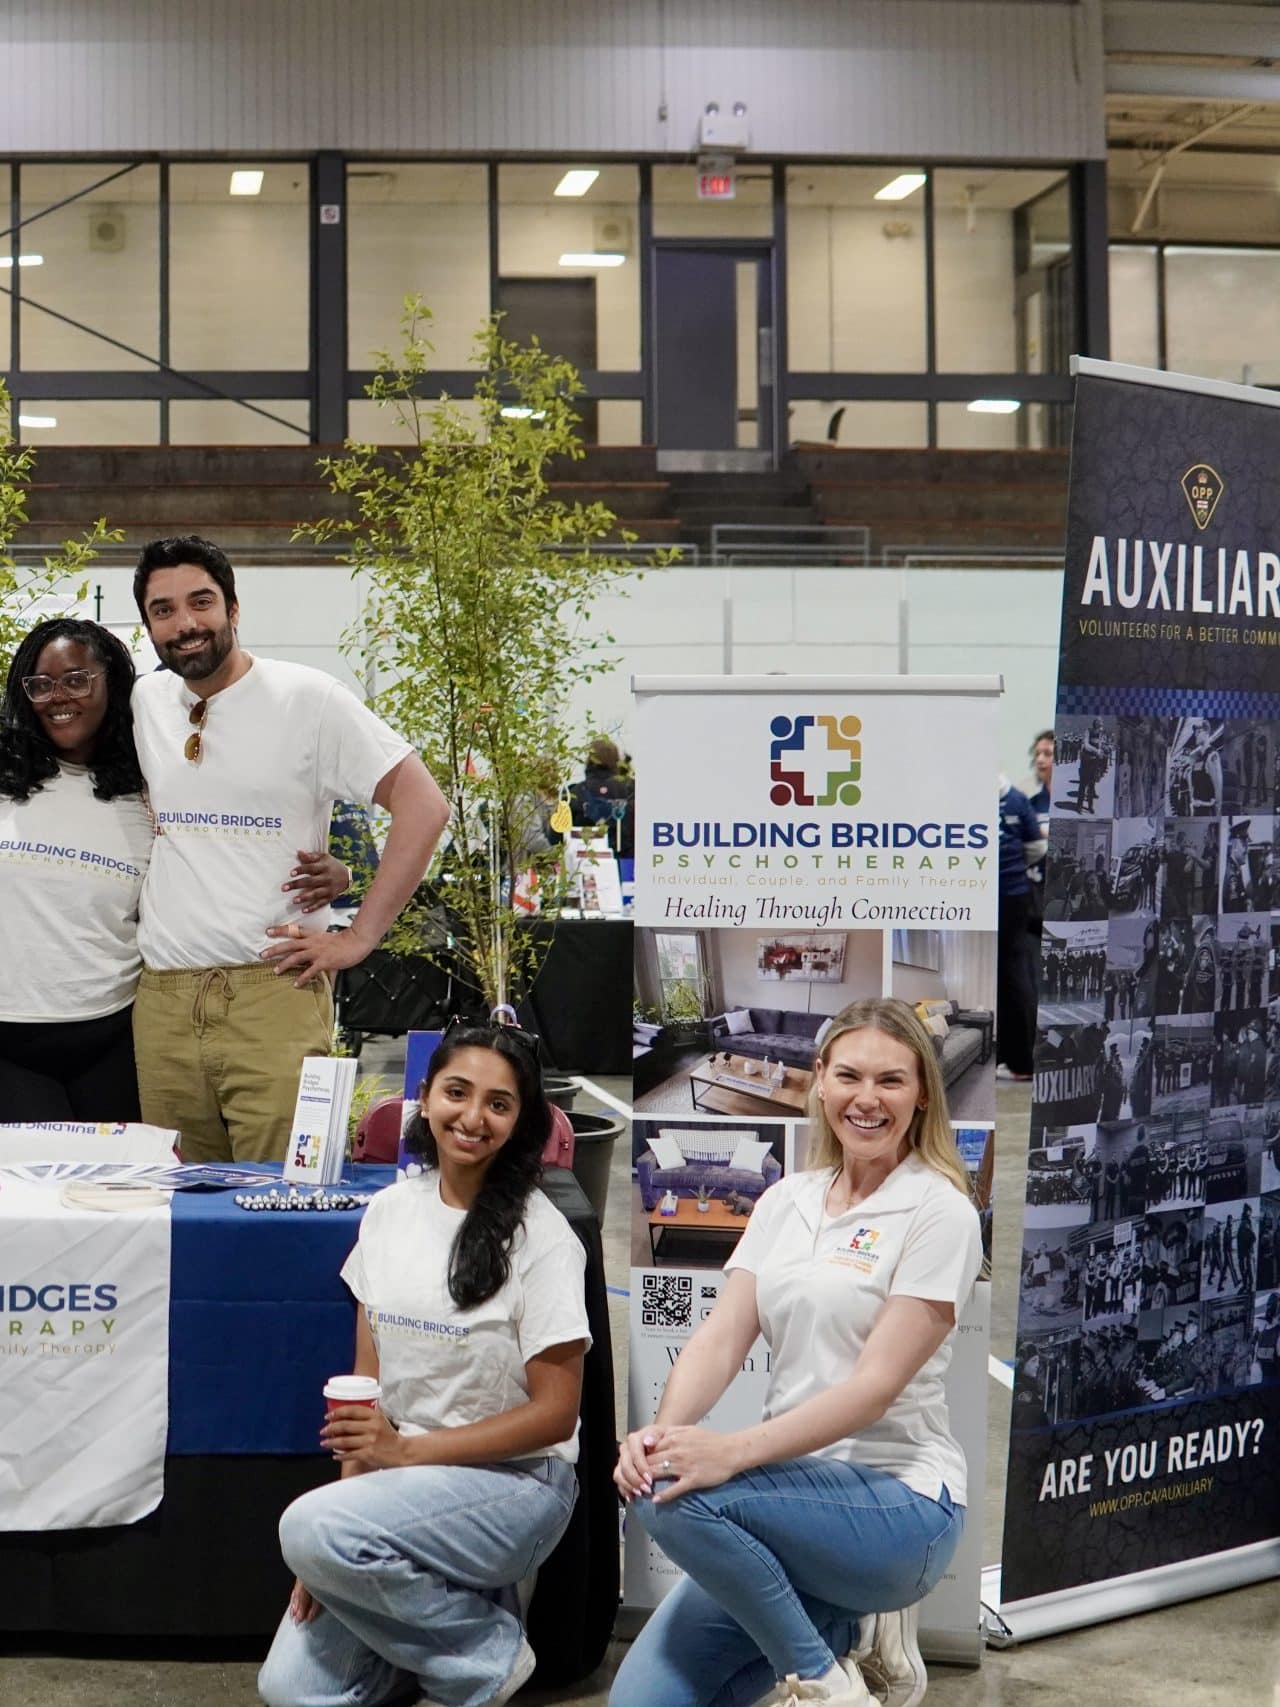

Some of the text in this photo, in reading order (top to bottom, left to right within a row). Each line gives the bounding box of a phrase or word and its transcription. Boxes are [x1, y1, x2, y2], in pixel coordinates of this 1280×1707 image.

[1080, 619, 1157, 640] VOLUNTEERS
[1160, 624, 1180, 640] FOR
[1186, 626, 1194, 641] A
[1199, 627, 1239, 644] BETTER
[160, 812, 282, 829] BUILDING BRIDGES
[653, 822, 989, 849] BUILDING BRIDGES
[0, 840, 141, 877] BUILDING BRIDGES
[653, 854, 987, 870] PSYCHOTHERAPY
[653, 873, 988, 889] Individual, Couple, and Family Therapy
[664, 895, 972, 926] Healing Through Connection
[378, 1312, 421, 1328] BUILDING
[423, 1321, 470, 1336] BRIDGES
[40, 1341, 117, 1356] Therapy
[1039, 1418, 1265, 1501] ARE YOU READY?
[1089, 1476, 1215, 1517] WWW.OPP.CA/AUXILIARY
